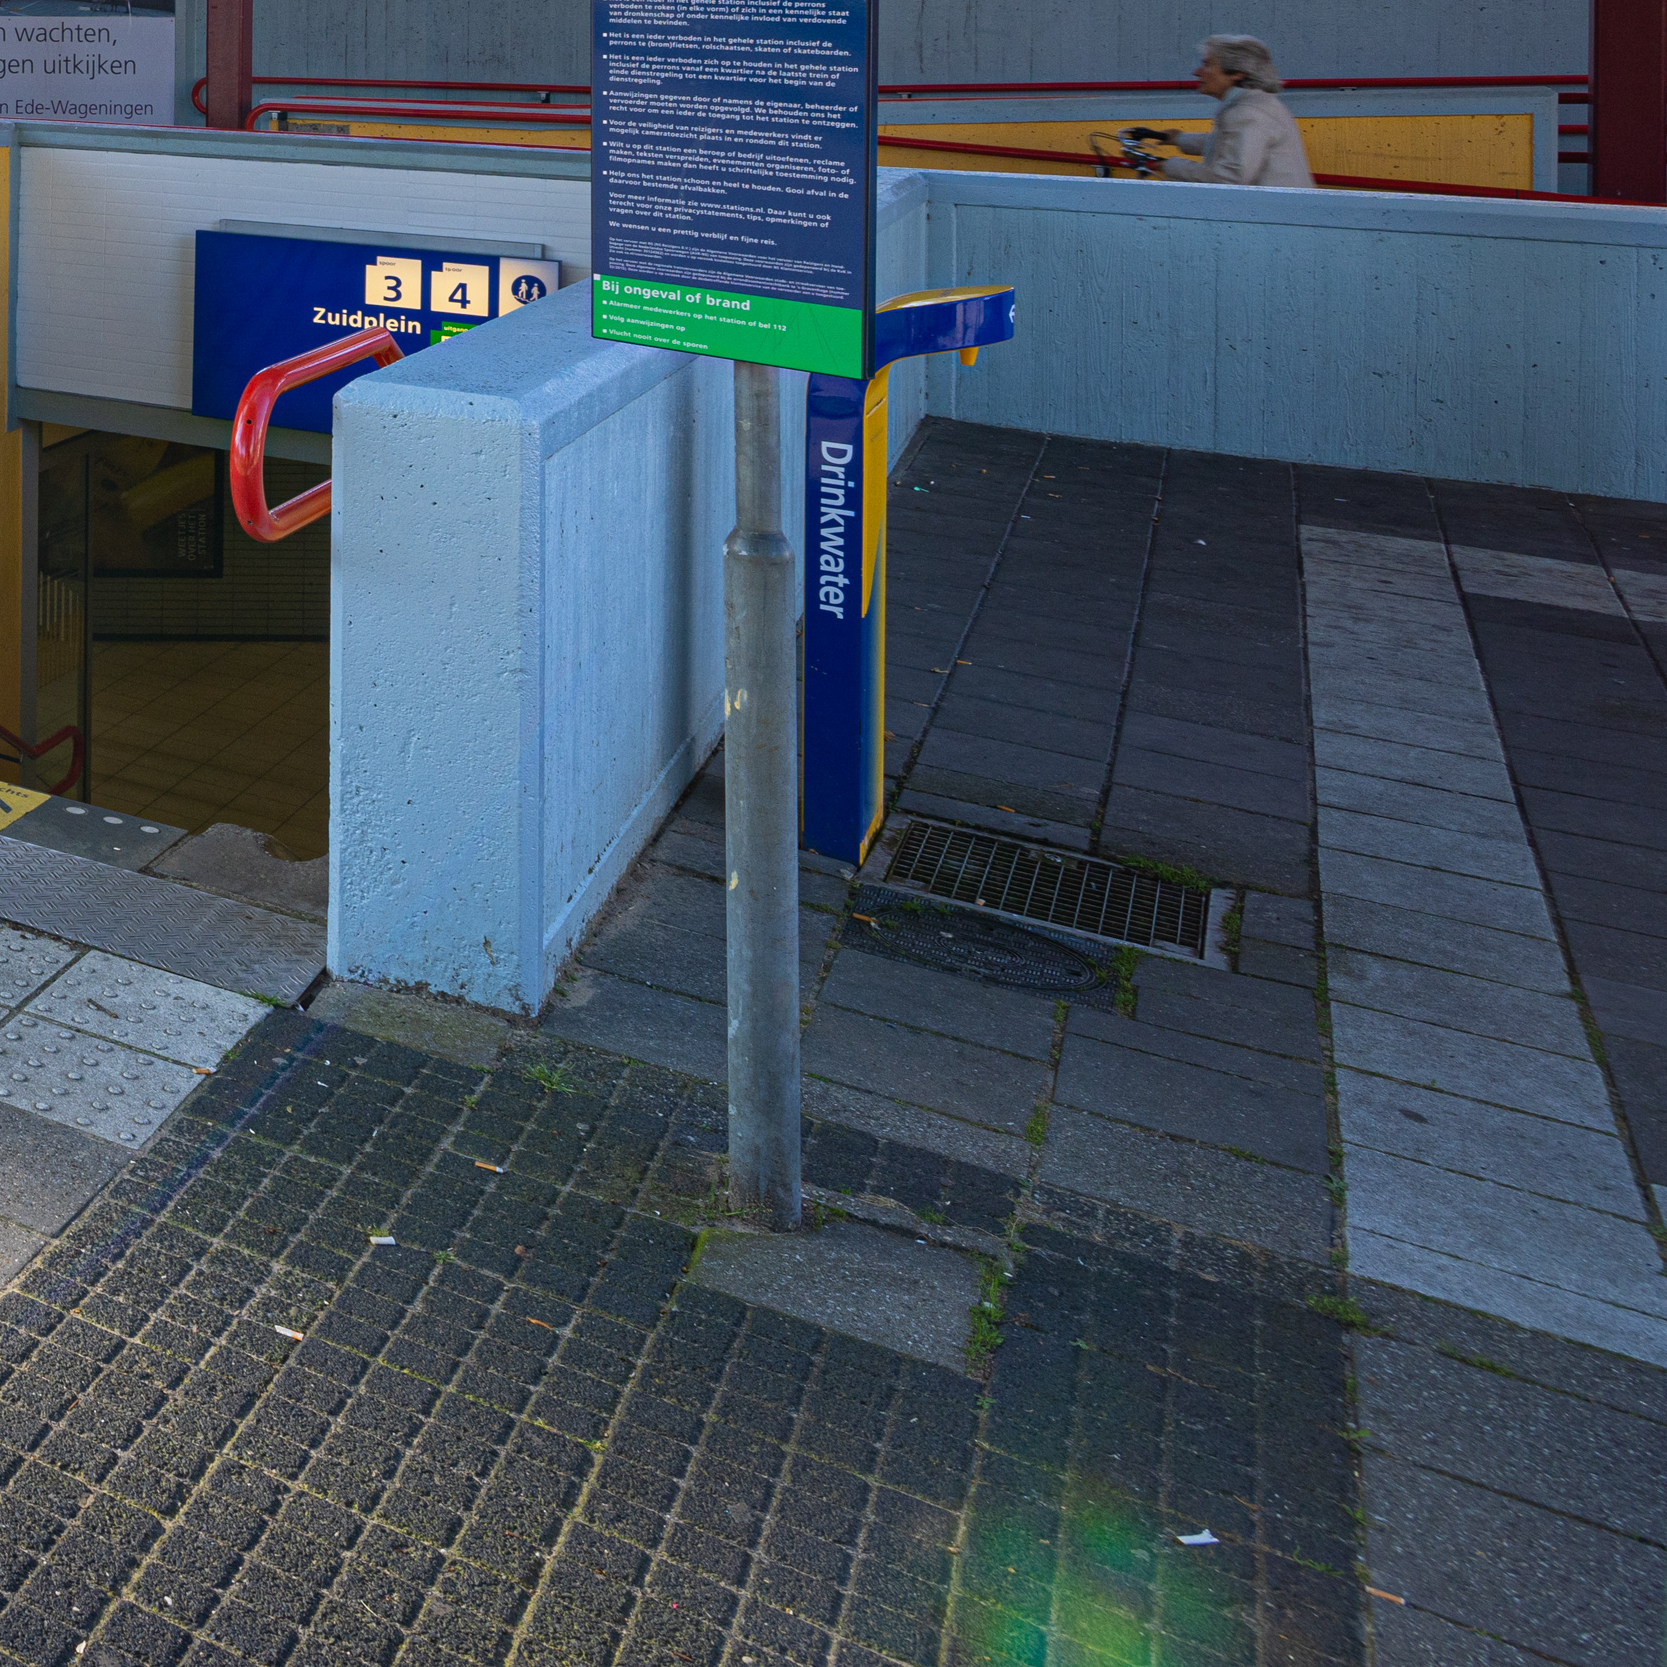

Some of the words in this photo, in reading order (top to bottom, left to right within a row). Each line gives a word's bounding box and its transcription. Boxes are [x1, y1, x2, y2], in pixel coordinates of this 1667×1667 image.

[14, 22, 118, 47] wachten,
[43, 54, 137, 80] uitkijken
[15, 99, 154, 120] Ede-Wageningen
[383, 275, 403, 302] 3
[448, 282, 471, 310] 4
[601, 280, 619, 294] Bij
[623, 285, 681, 301] ongeval
[684, 291, 701, 304] of
[705, 296, 750, 311] brand
[312, 306, 422, 335] Zuidplein
[608, 299, 641, 310] Alarmeer
[642, 303, 691, 317] medewerkers
[692, 312, 703, 320] op
[703, 312, 717, 321] het
[718, 314, 746, 325] station
[747, 319, 756, 327] of
[757, 320, 771, 329] bel
[772, 322, 787, 331] 112
[608, 314, 625, 323] Volg
[625, 315, 674, 329] aanwijzingen
[675, 324, 685, 332] op
[608, 328, 631, 337] Vlucht
[632, 331, 652, 341] nooit
[653, 335, 670, 343] over
[670, 337, 681, 345] de
[682, 340, 708, 351] sporen
[819, 440, 855, 620] Drinkwater
